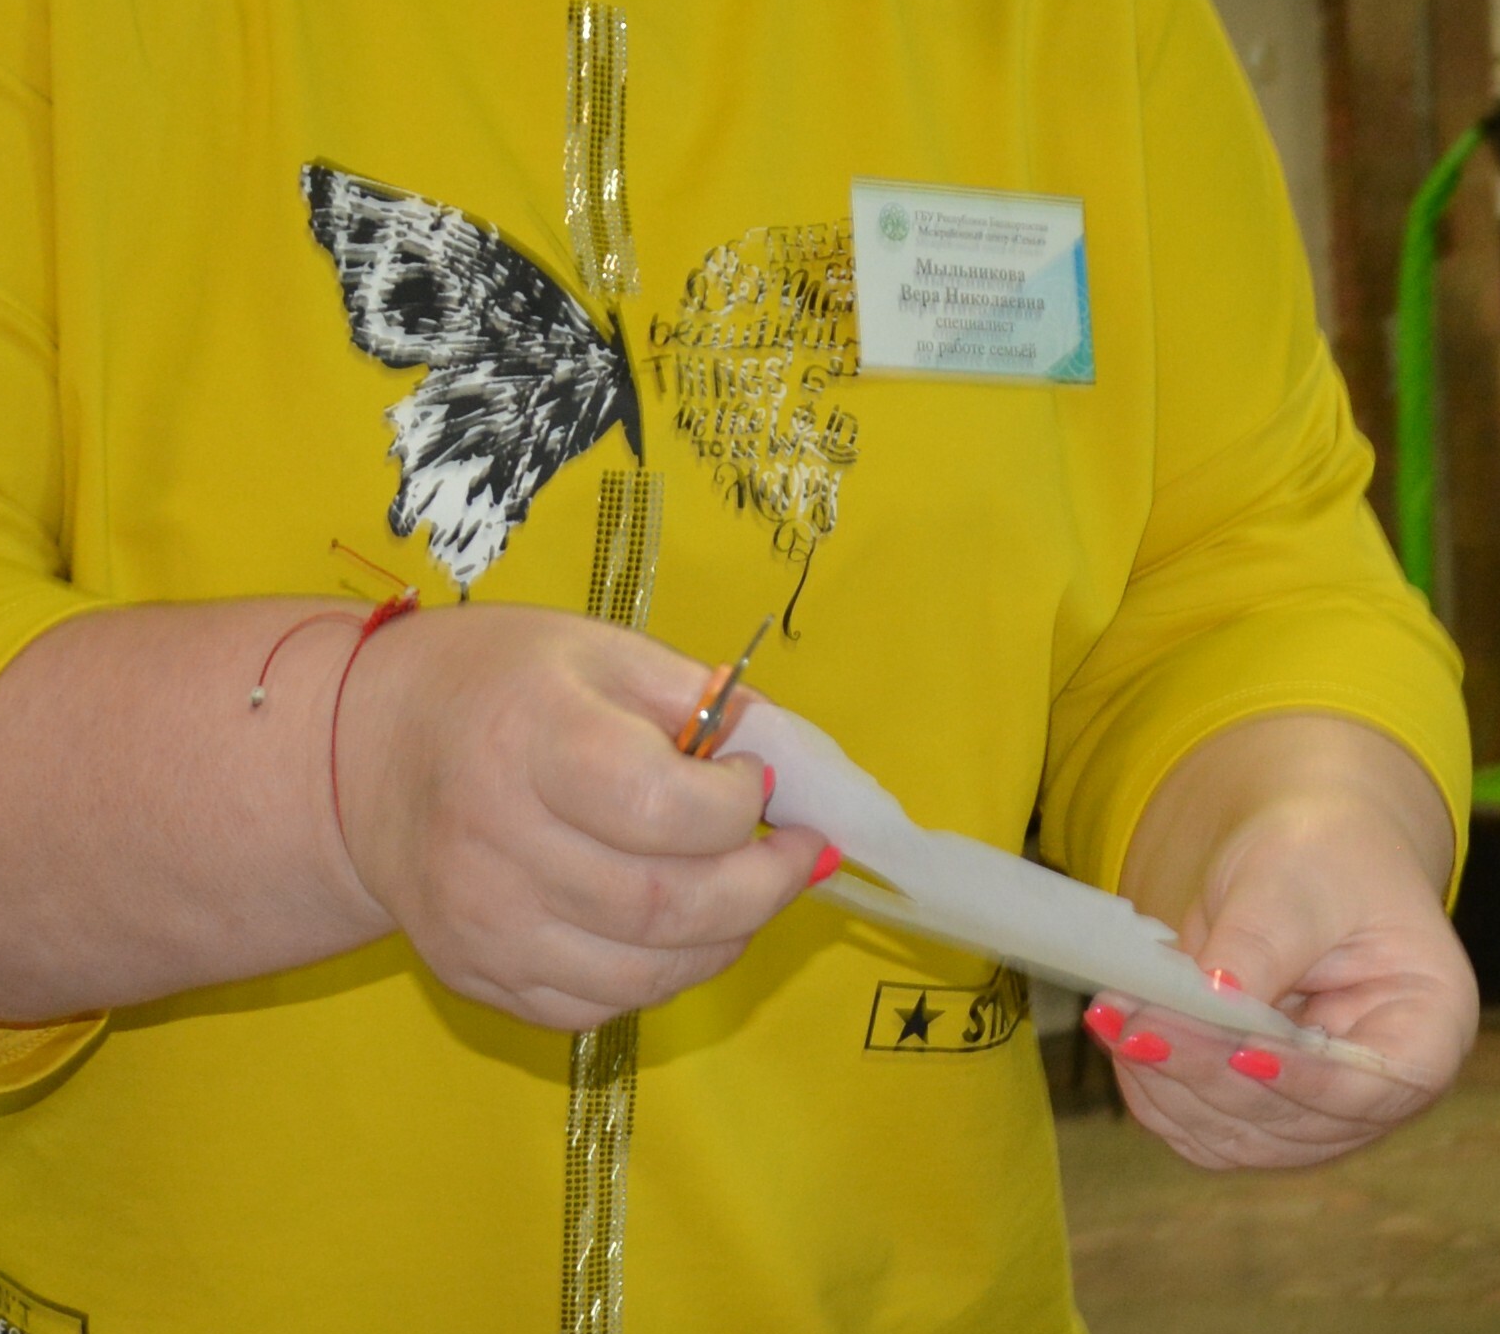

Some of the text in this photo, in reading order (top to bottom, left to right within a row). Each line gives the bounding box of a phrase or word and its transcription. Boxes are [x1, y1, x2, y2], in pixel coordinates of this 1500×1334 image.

[915, 257, 1026, 283] Мыльникова
[900, 283, 1046, 311] Вера Николаевна
[935, 316, 1015, 334] специалист
[916, 339, 935, 354] по
[937, 337, 986, 359] работе
